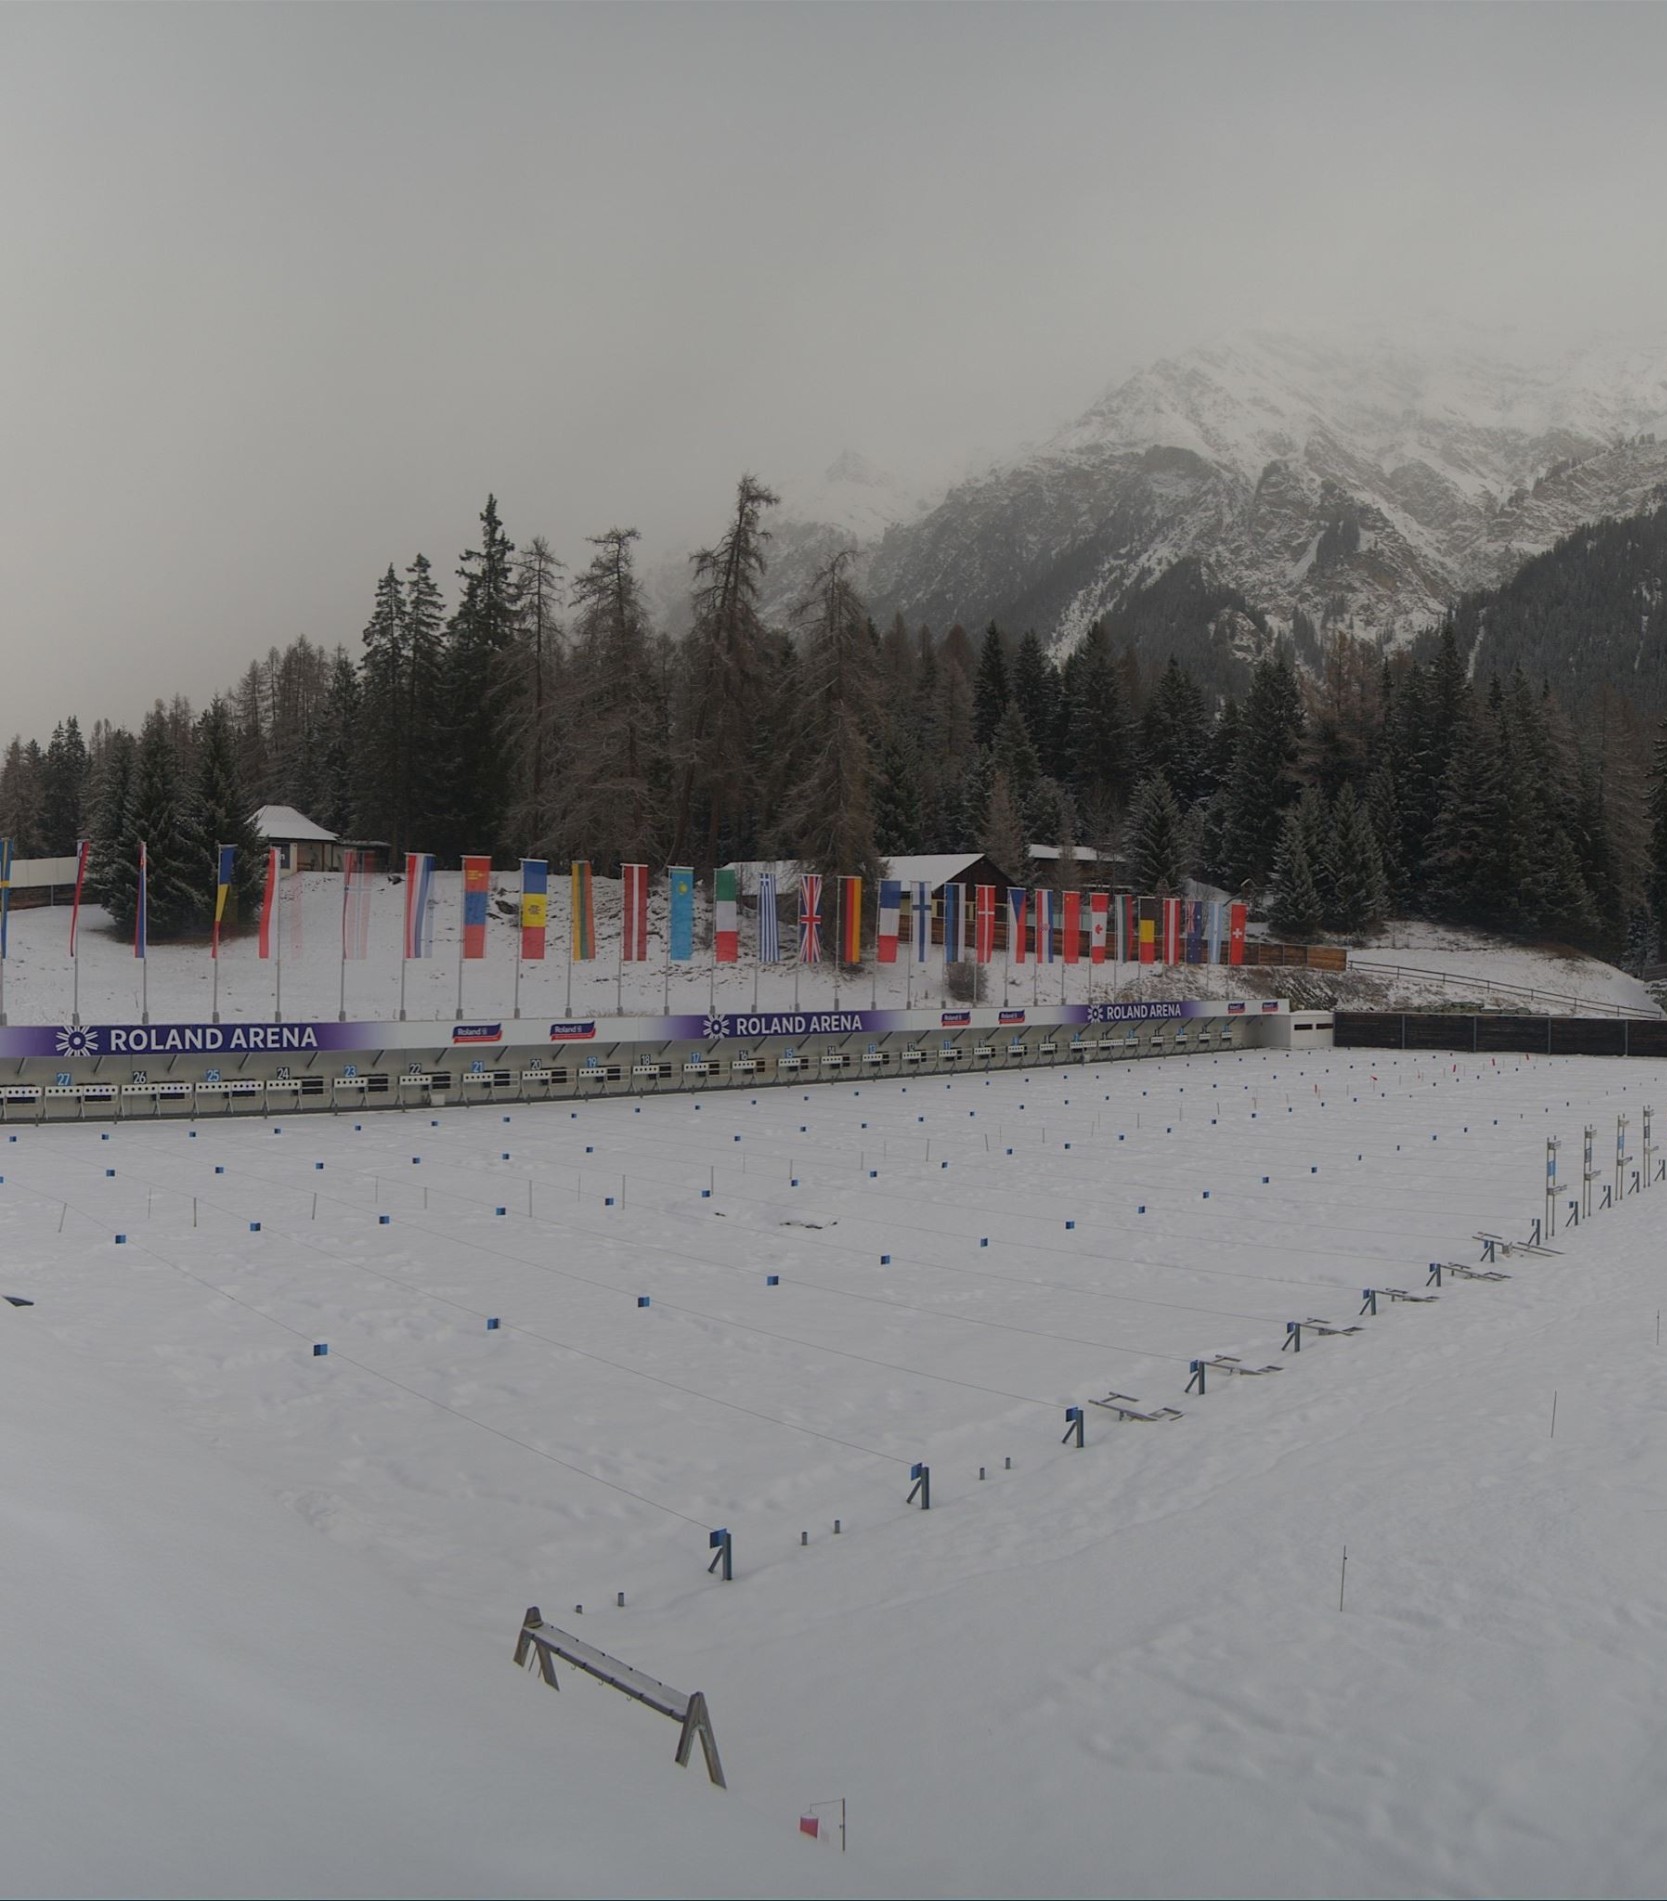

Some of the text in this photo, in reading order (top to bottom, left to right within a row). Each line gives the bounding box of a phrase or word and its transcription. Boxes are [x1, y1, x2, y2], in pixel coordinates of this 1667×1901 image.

[1107, 1003, 1182, 1020] ROLAND ARENA
[555, 1025, 577, 1034] Roland
[736, 1014, 863, 1035] ROLAND ARENA
[457, 1027, 482, 1036] Roland
[110, 1027, 319, 1051] ROLAND ARENA
[473, 1061, 483, 1073] 21
[530, 1059, 541, 1070] 20
[587, 1057, 598, 1068] 19
[278, 1067, 289, 1079] 24
[345, 1065, 357, 1077] 23
[410, 1063, 421, 1075] 22
[57, 1073, 70, 1086] 27
[133, 1071, 146, 1084] 26
[207, 1069, 220, 1082] 25
